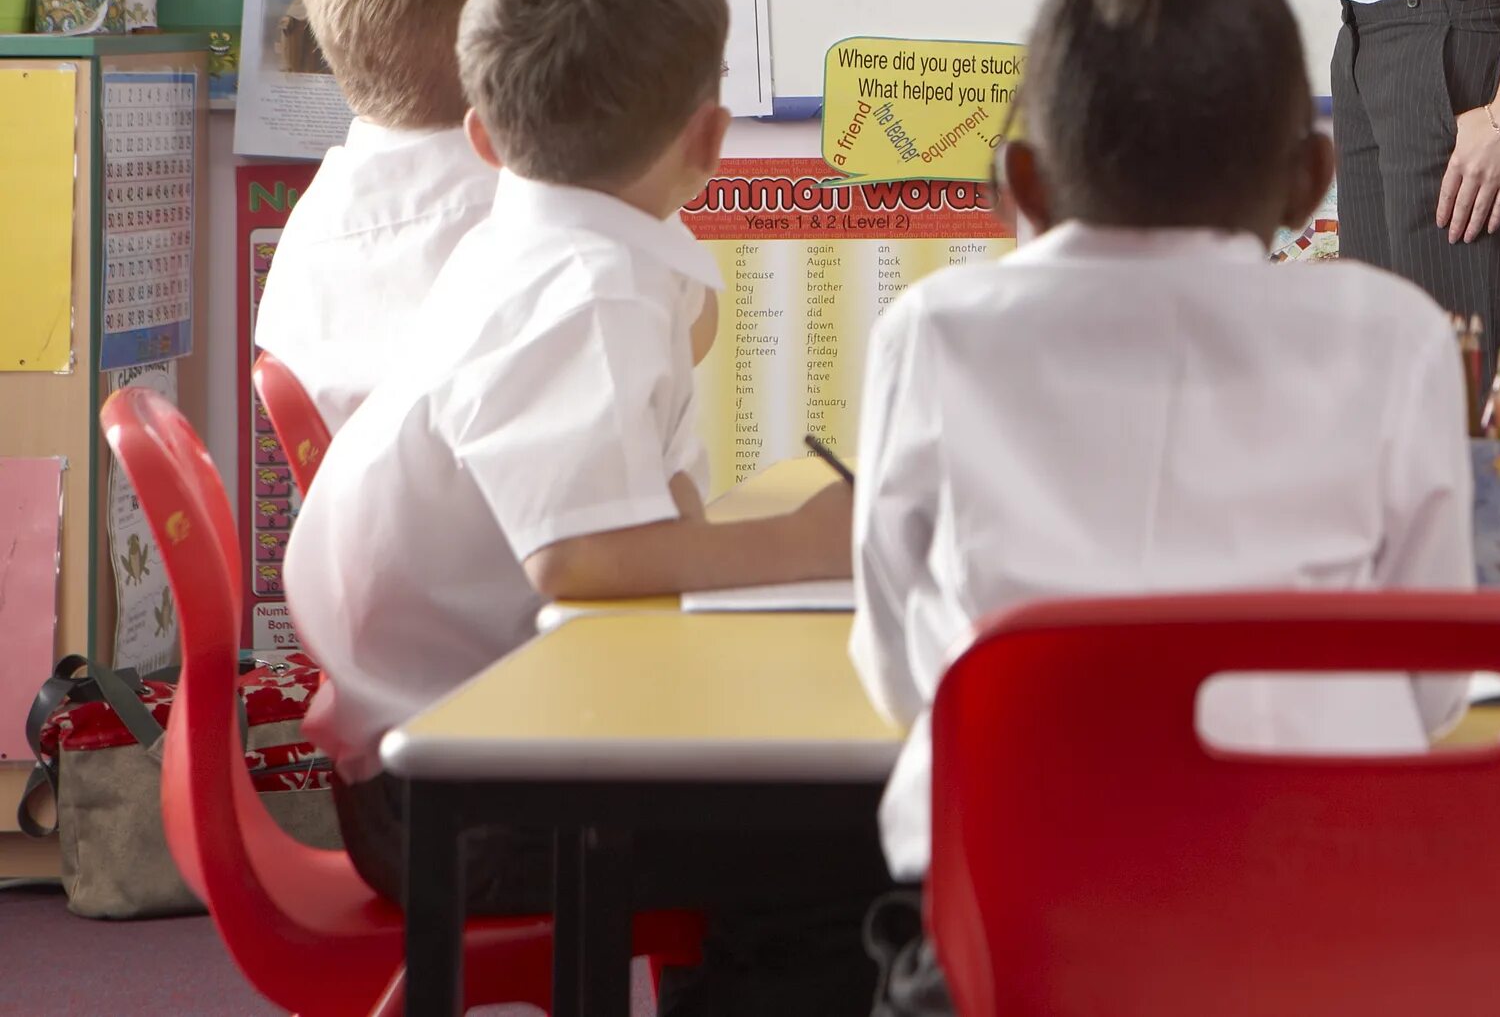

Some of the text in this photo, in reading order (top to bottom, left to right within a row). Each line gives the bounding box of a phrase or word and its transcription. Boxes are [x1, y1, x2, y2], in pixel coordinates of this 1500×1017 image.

[839, 48, 888, 69] Where
[893, 51, 915, 70] did
[920, 58, 947, 76] you
[952, 56, 976, 77] get
[859, 78, 898, 98] What
[903, 80, 954, 105] helped
[959, 89, 985, 106] you
[834, 100, 872, 166] a friend
[872, 102, 920, 163] the teacher
[921, 105, 989, 164] equipment
[744, 214, 910, 231] Years 1 & 2 (Level 2)
[736, 244, 759, 254] after
[807, 244, 834, 254] again
[949, 244, 987, 252] another
[807, 257, 841, 267] August
[878, 257, 900, 265] back
[736, 270, 774, 279] because
[807, 270, 824, 278] bed
[878, 270, 900, 278] been
[736, 283, 754, 293] boy
[807, 282, 843, 291] brother
[736, 296, 752, 304] call
[807, 295, 835, 304] called
[736, 309, 783, 317] December
[807, 308, 822, 317] did
[736, 321, 758, 330] door
[807, 321, 834, 329] down
[736, 334, 779, 345] February
[807, 333, 837, 344] fifteen
[735, 347, 776, 357] fourteen
[807, 346, 838, 357] Friday
[736, 360, 751, 370] got
[807, 360, 833, 369] green
[806, 397, 846, 408] January
